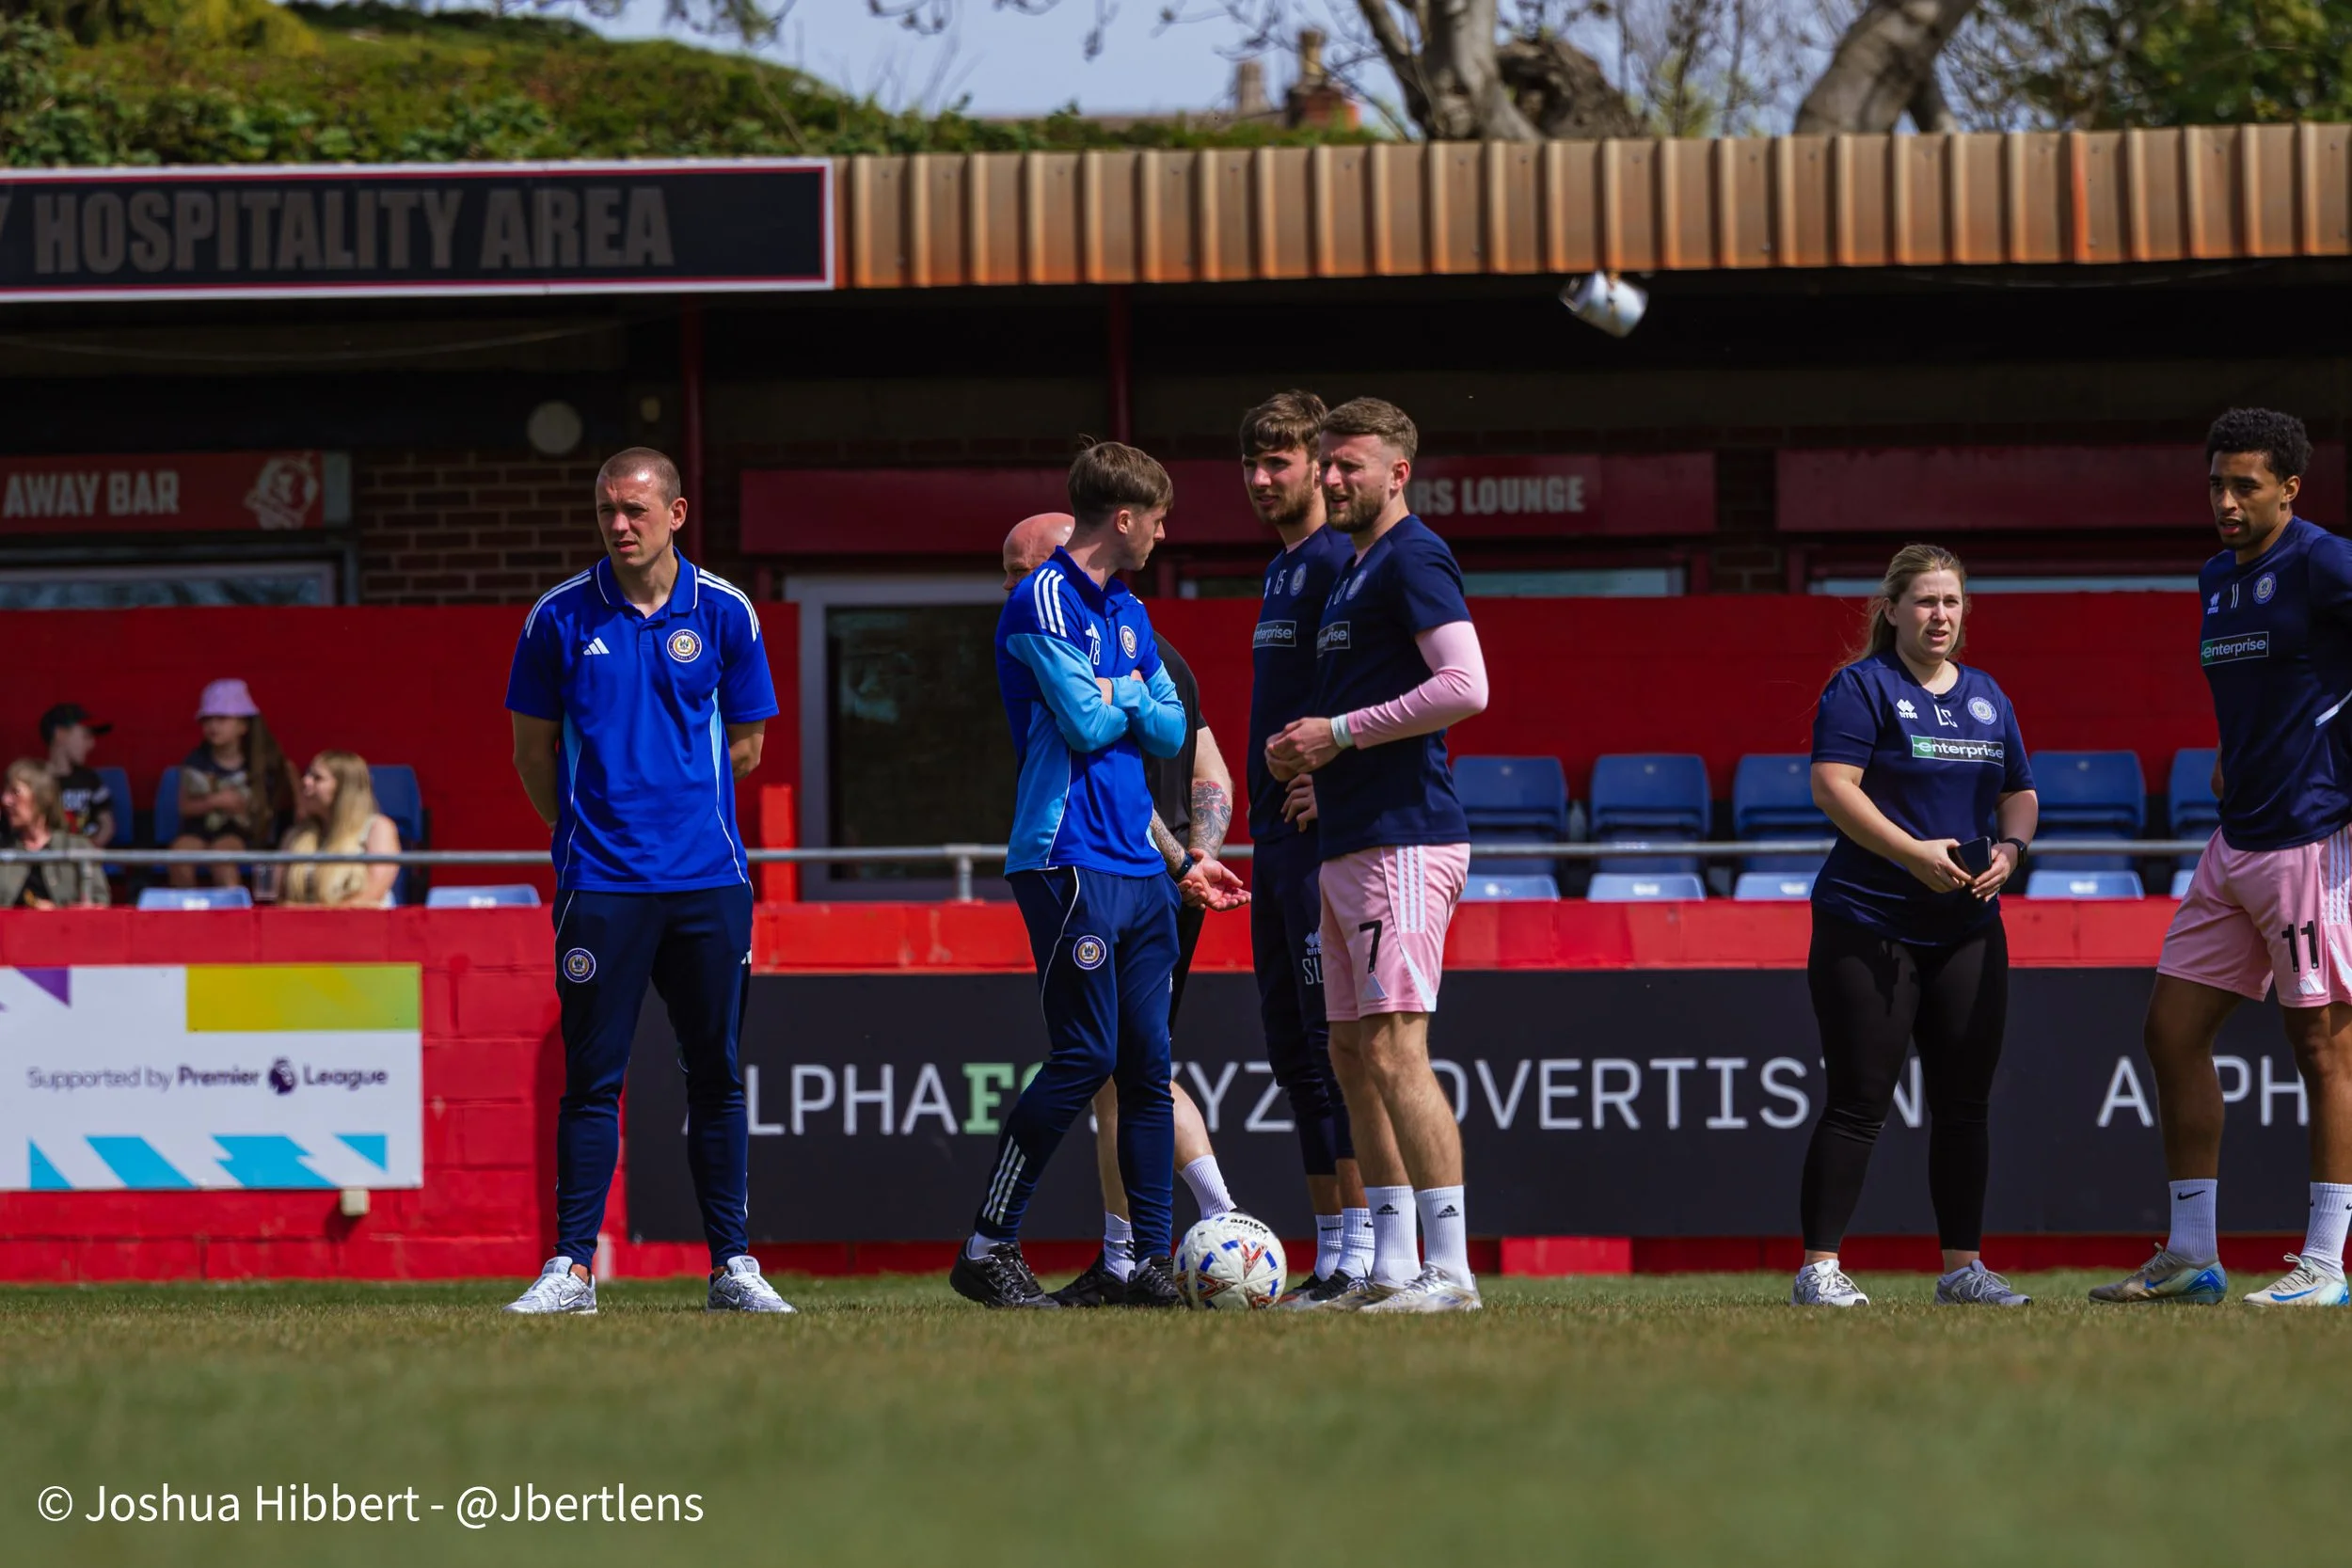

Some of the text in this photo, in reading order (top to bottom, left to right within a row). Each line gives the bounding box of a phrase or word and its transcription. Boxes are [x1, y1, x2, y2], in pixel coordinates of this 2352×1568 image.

[34, 189, 464, 274] HOSPITALITY
[480, 186, 675, 269] AREA
[3, 470, 180, 518] AWAY BAR
[1410, 475, 1584, 515] RS LOUNGE
[1254, 625, 1294, 643] nterprise
[2202, 637, 2267, 658] enterprise
[1917, 740, 2004, 759] enterprise
[1359, 919, 1383, 974] 7
[2281, 920, 2320, 973] 11
[26, 1062, 389, 1093] Supported by Premier League
[681, 1060, 1043, 1136] LPHAF
[1429, 1056, 1922, 1130] DVERTISN
[2096, 1054, 2310, 1127] APH
